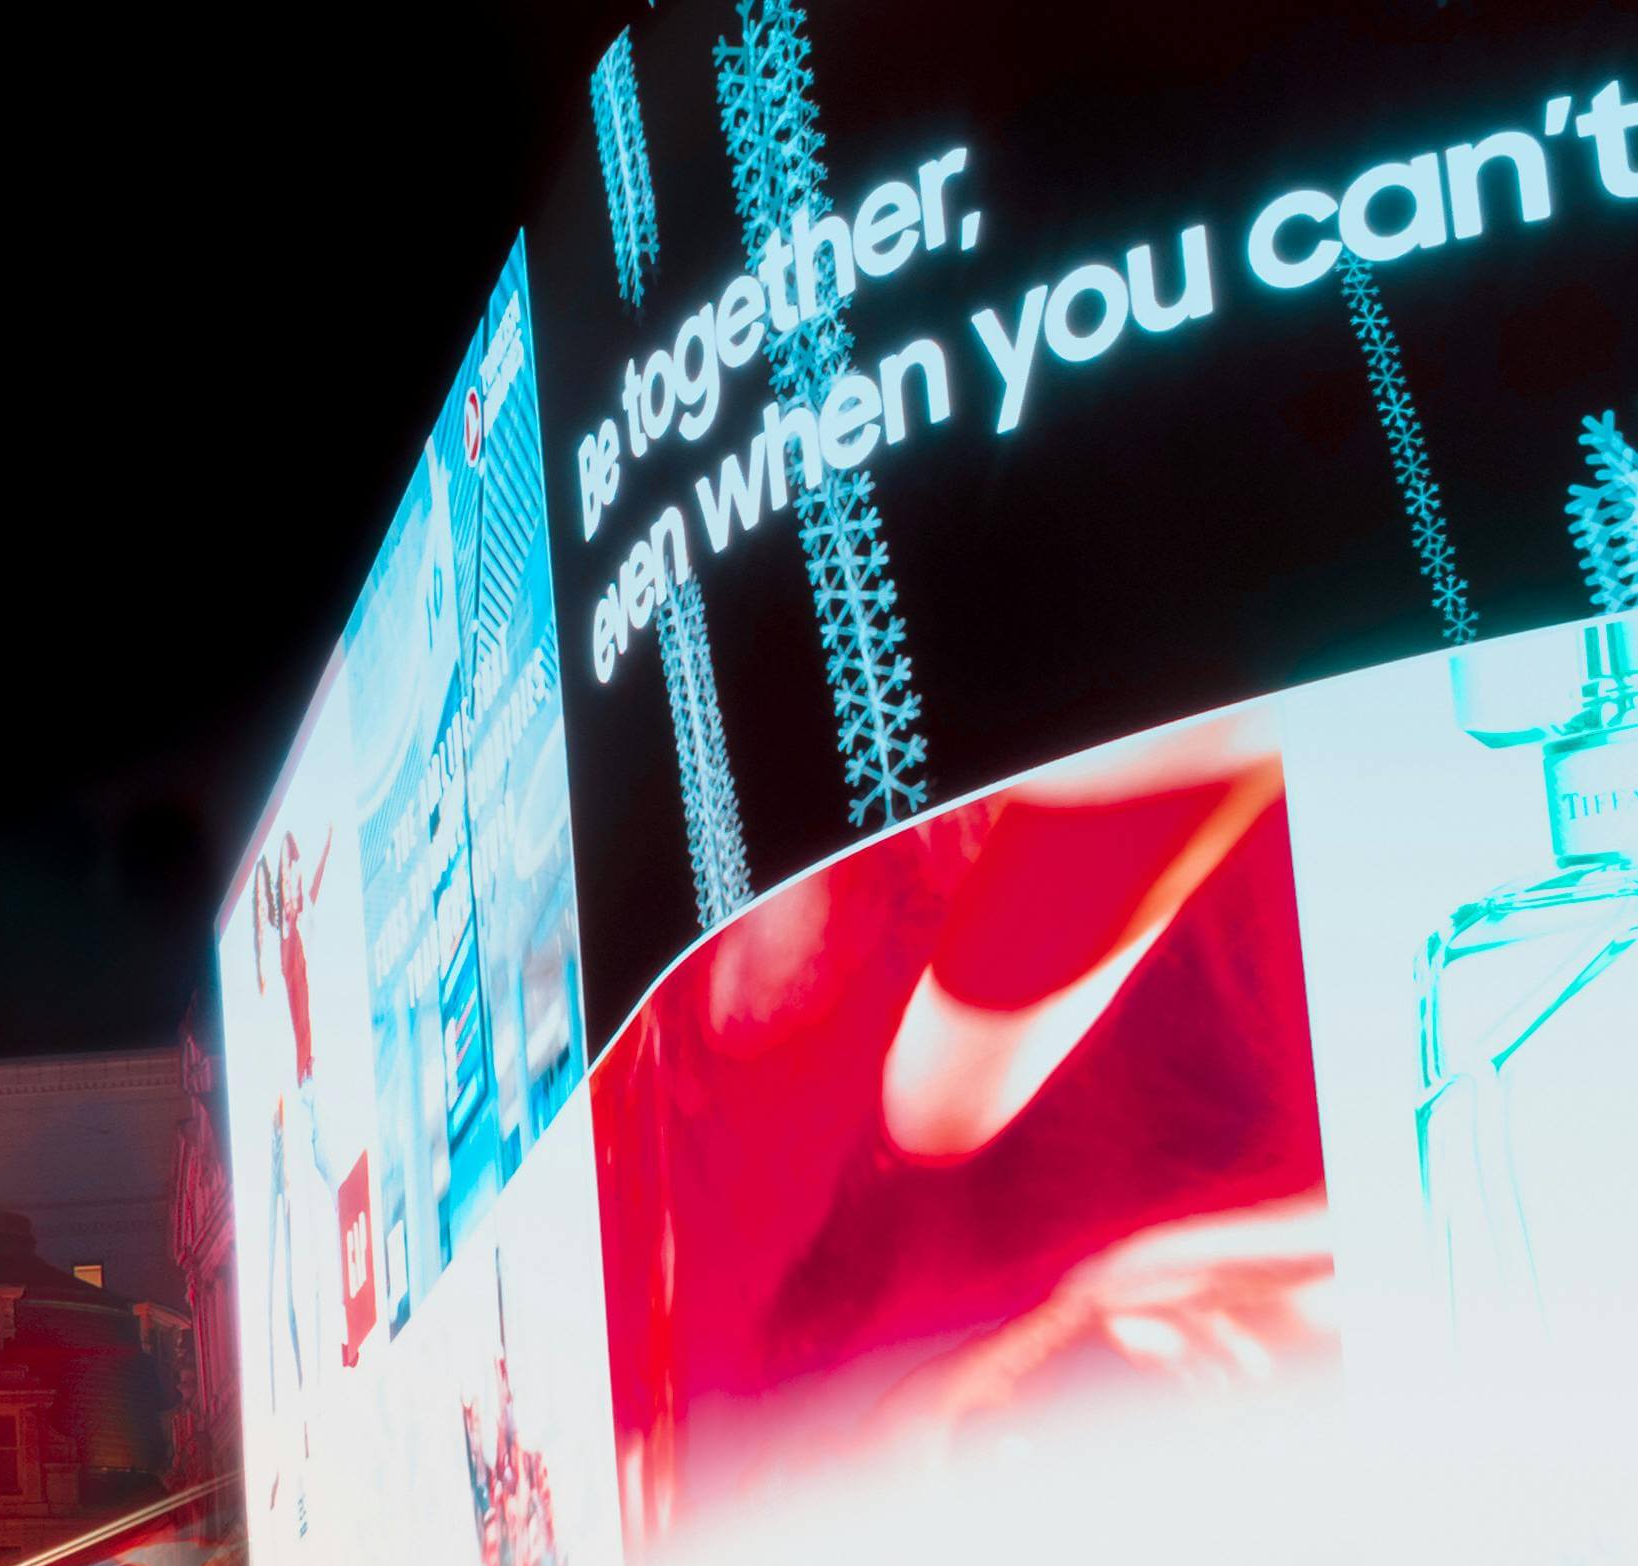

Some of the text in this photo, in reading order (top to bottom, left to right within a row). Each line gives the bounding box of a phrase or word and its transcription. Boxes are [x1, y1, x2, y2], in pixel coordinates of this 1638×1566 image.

[579, 417, 619, 541] Be
[622, 147, 981, 458] together,
[593, 506, 690, 684] even
[697, 339, 952, 553] when
[973, 226, 1215, 433] you
[1248, 80, 1638, 289] can't
